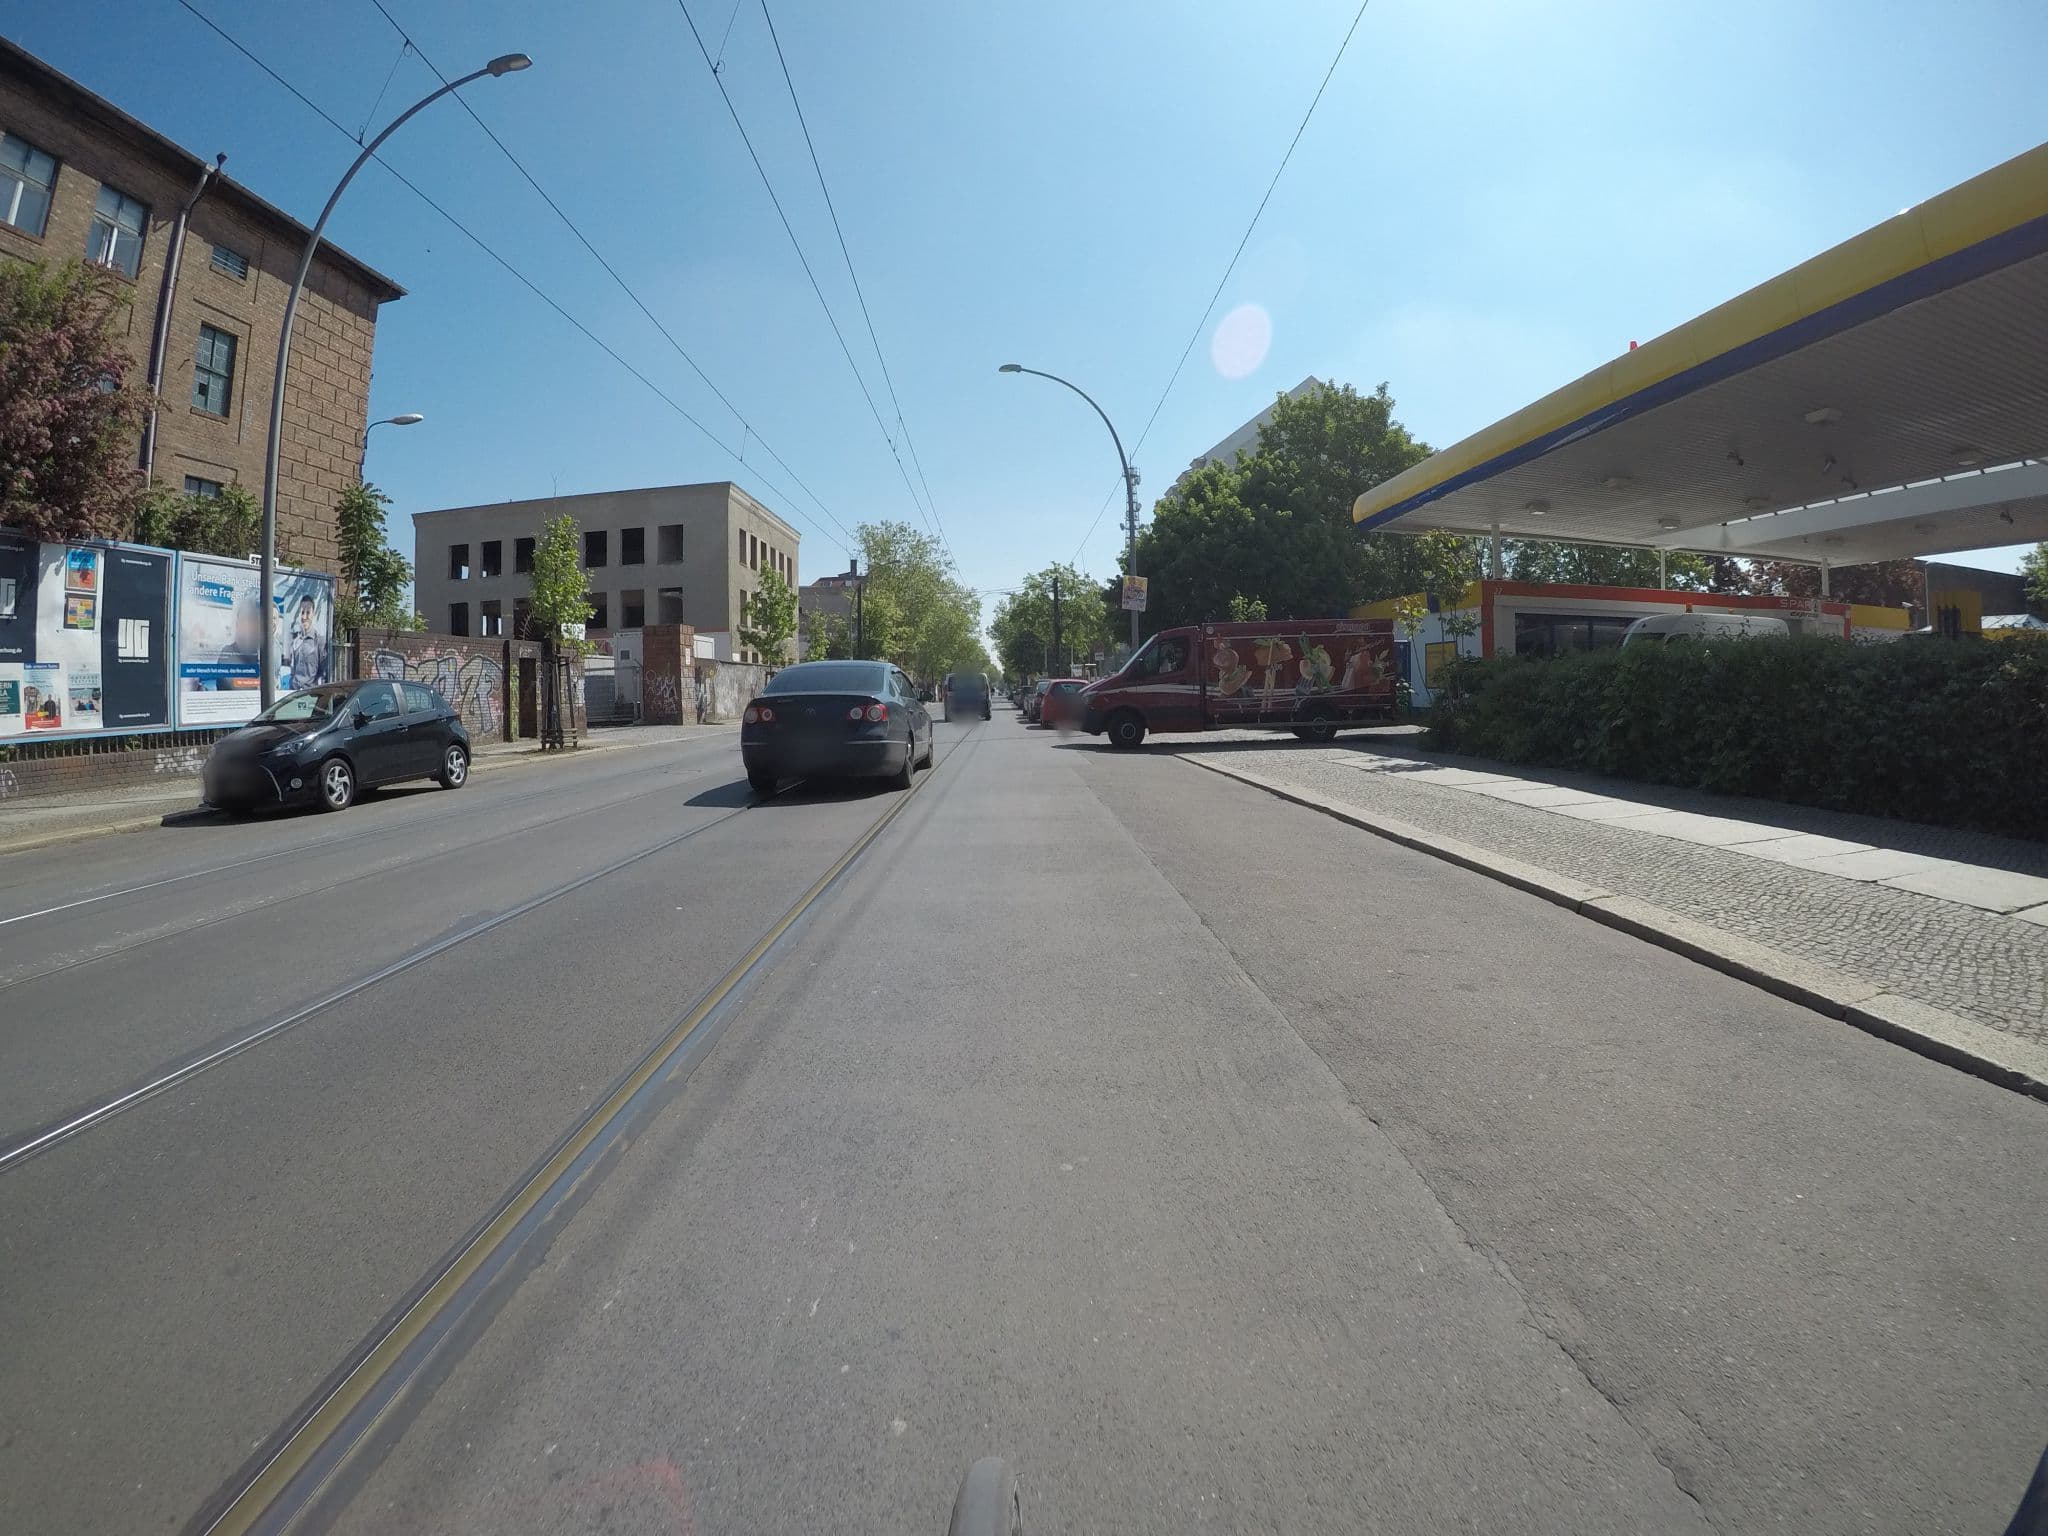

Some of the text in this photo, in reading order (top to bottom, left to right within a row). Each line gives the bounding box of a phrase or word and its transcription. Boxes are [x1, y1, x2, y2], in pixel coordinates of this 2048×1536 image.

[192, 571, 220, 583] Unsere
[221, 574, 239, 585] Bank
[189, 585, 218, 597] andere
[1780, 599, 1811, 610] SPAR
